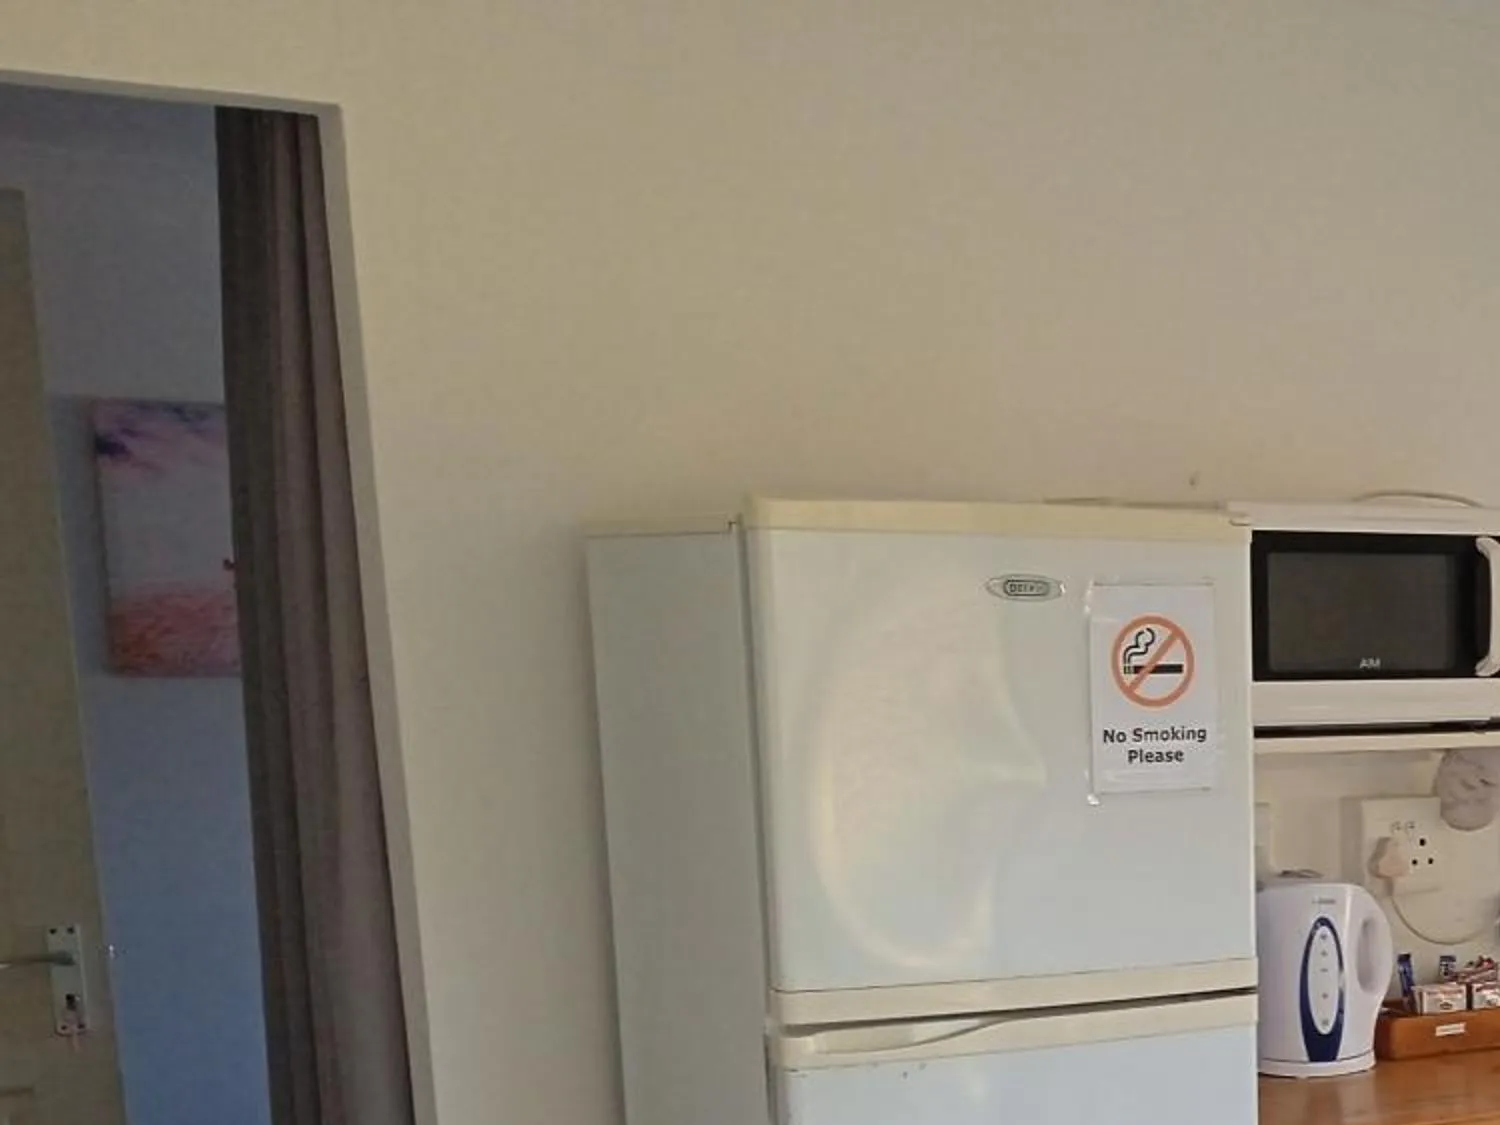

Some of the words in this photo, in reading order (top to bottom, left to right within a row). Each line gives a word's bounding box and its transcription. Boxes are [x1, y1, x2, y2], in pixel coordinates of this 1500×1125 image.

[1103, 728, 1127, 743] No
[1132, 726, 1207, 743] Smoking
[1127, 748, 1185, 764] Please
